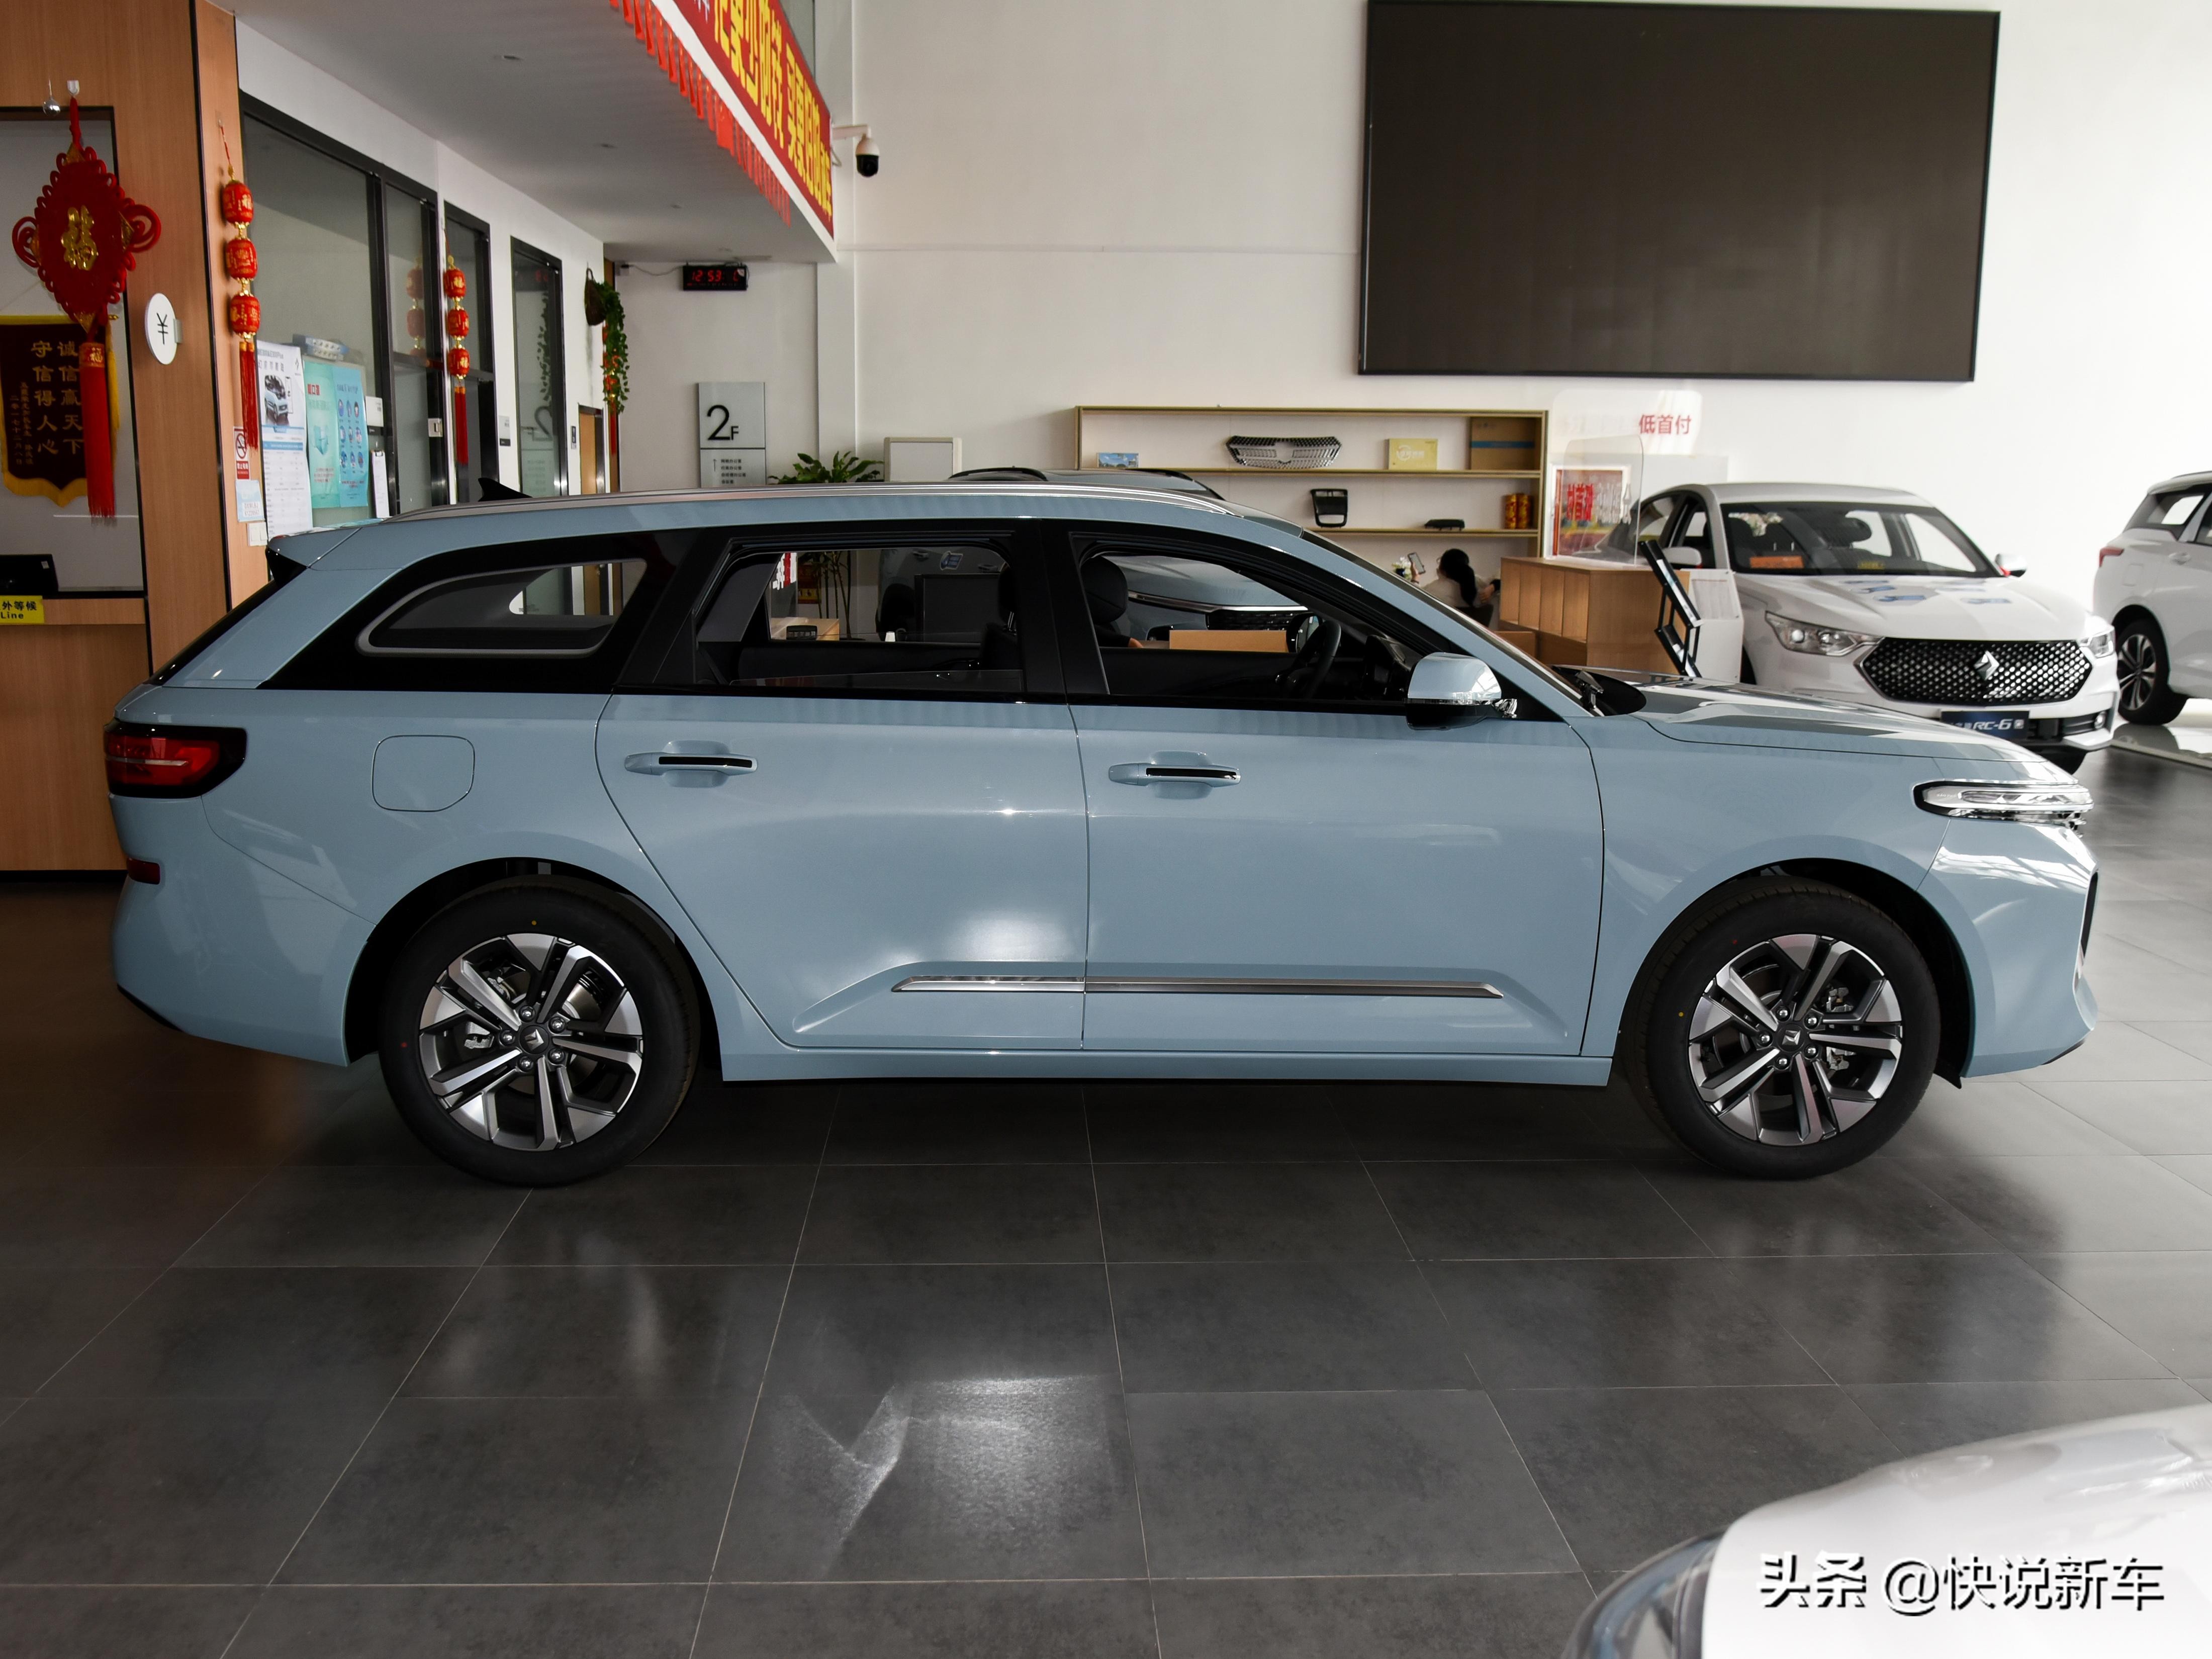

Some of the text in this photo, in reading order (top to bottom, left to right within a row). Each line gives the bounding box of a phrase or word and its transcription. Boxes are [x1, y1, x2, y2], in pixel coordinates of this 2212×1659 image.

[31, 340, 59, 455] 守信得人心
[707, 404, 739, 441] 2F
[1638, 414, 1692, 435] 低首付
[1972, 718, 2013, 730] RC-6
